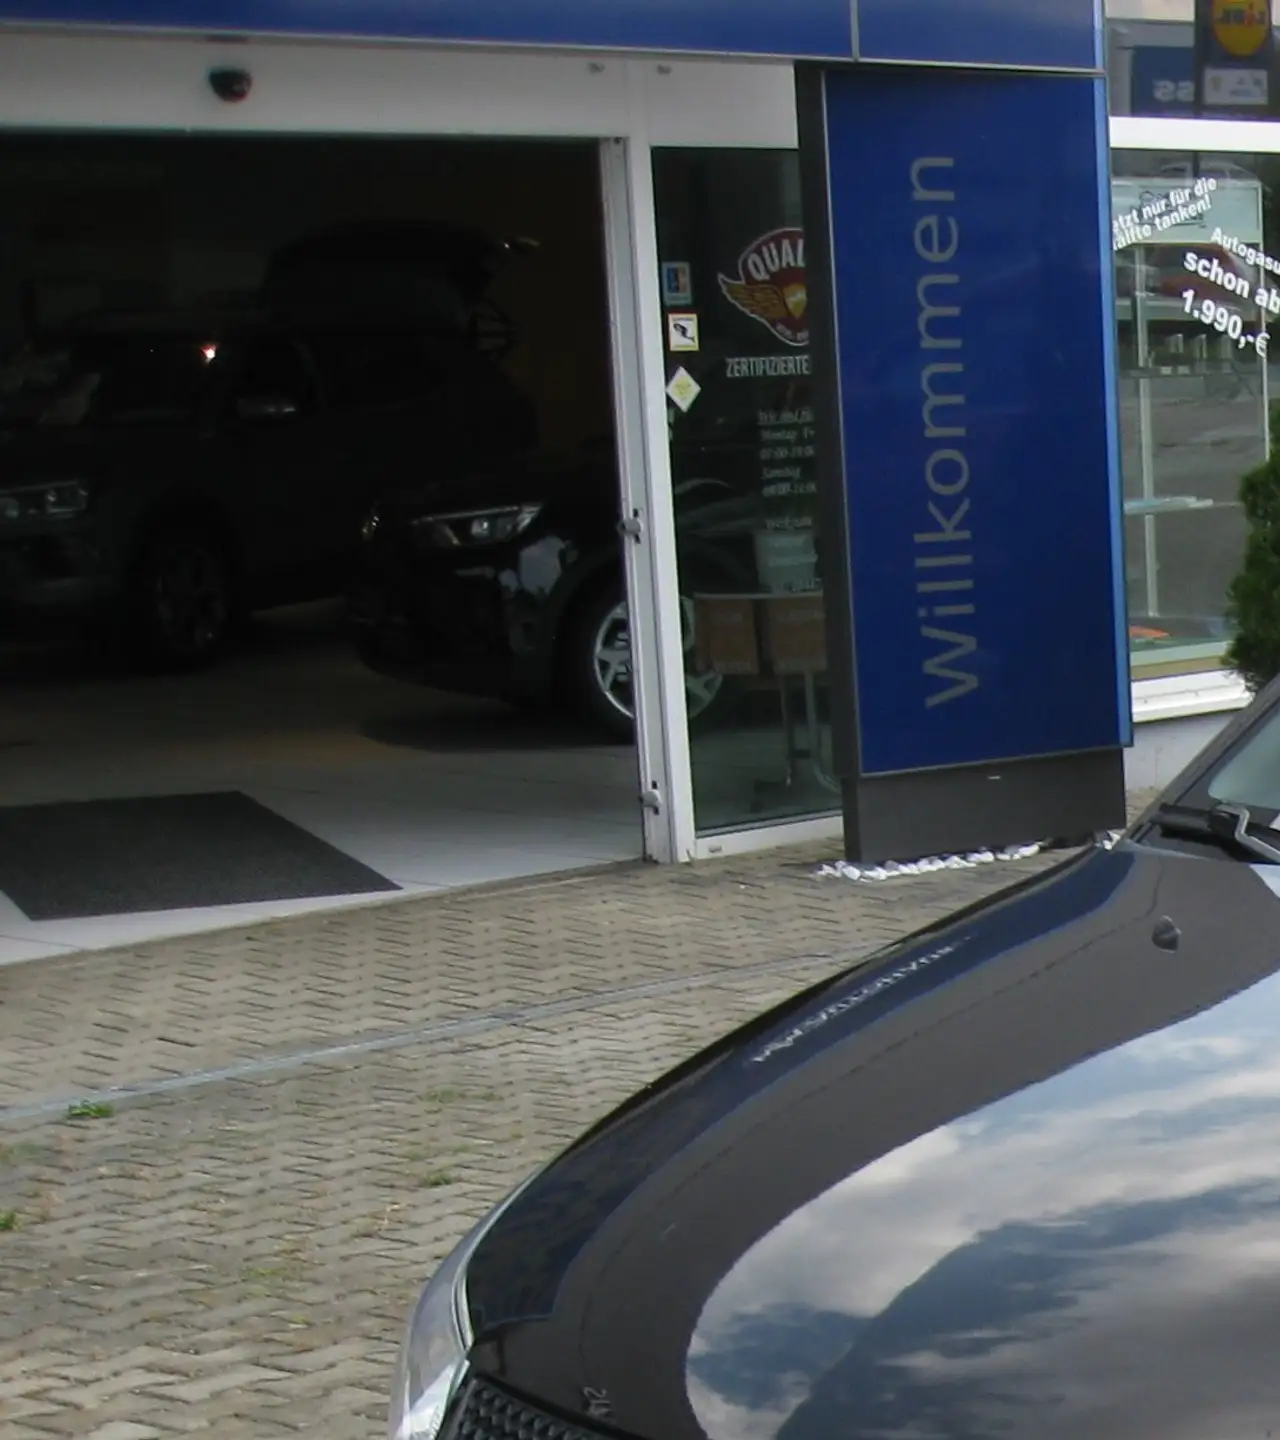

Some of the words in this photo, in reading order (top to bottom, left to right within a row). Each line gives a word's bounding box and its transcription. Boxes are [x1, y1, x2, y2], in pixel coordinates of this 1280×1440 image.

[1113, 208, 1140, 233] etzt
[1142, 197, 1168, 220] nur
[1169, 188, 1192, 206] für
[1194, 177, 1218, 196] die
[747, 238, 806, 282] QUAL
[1183, 251, 1250, 299] schon
